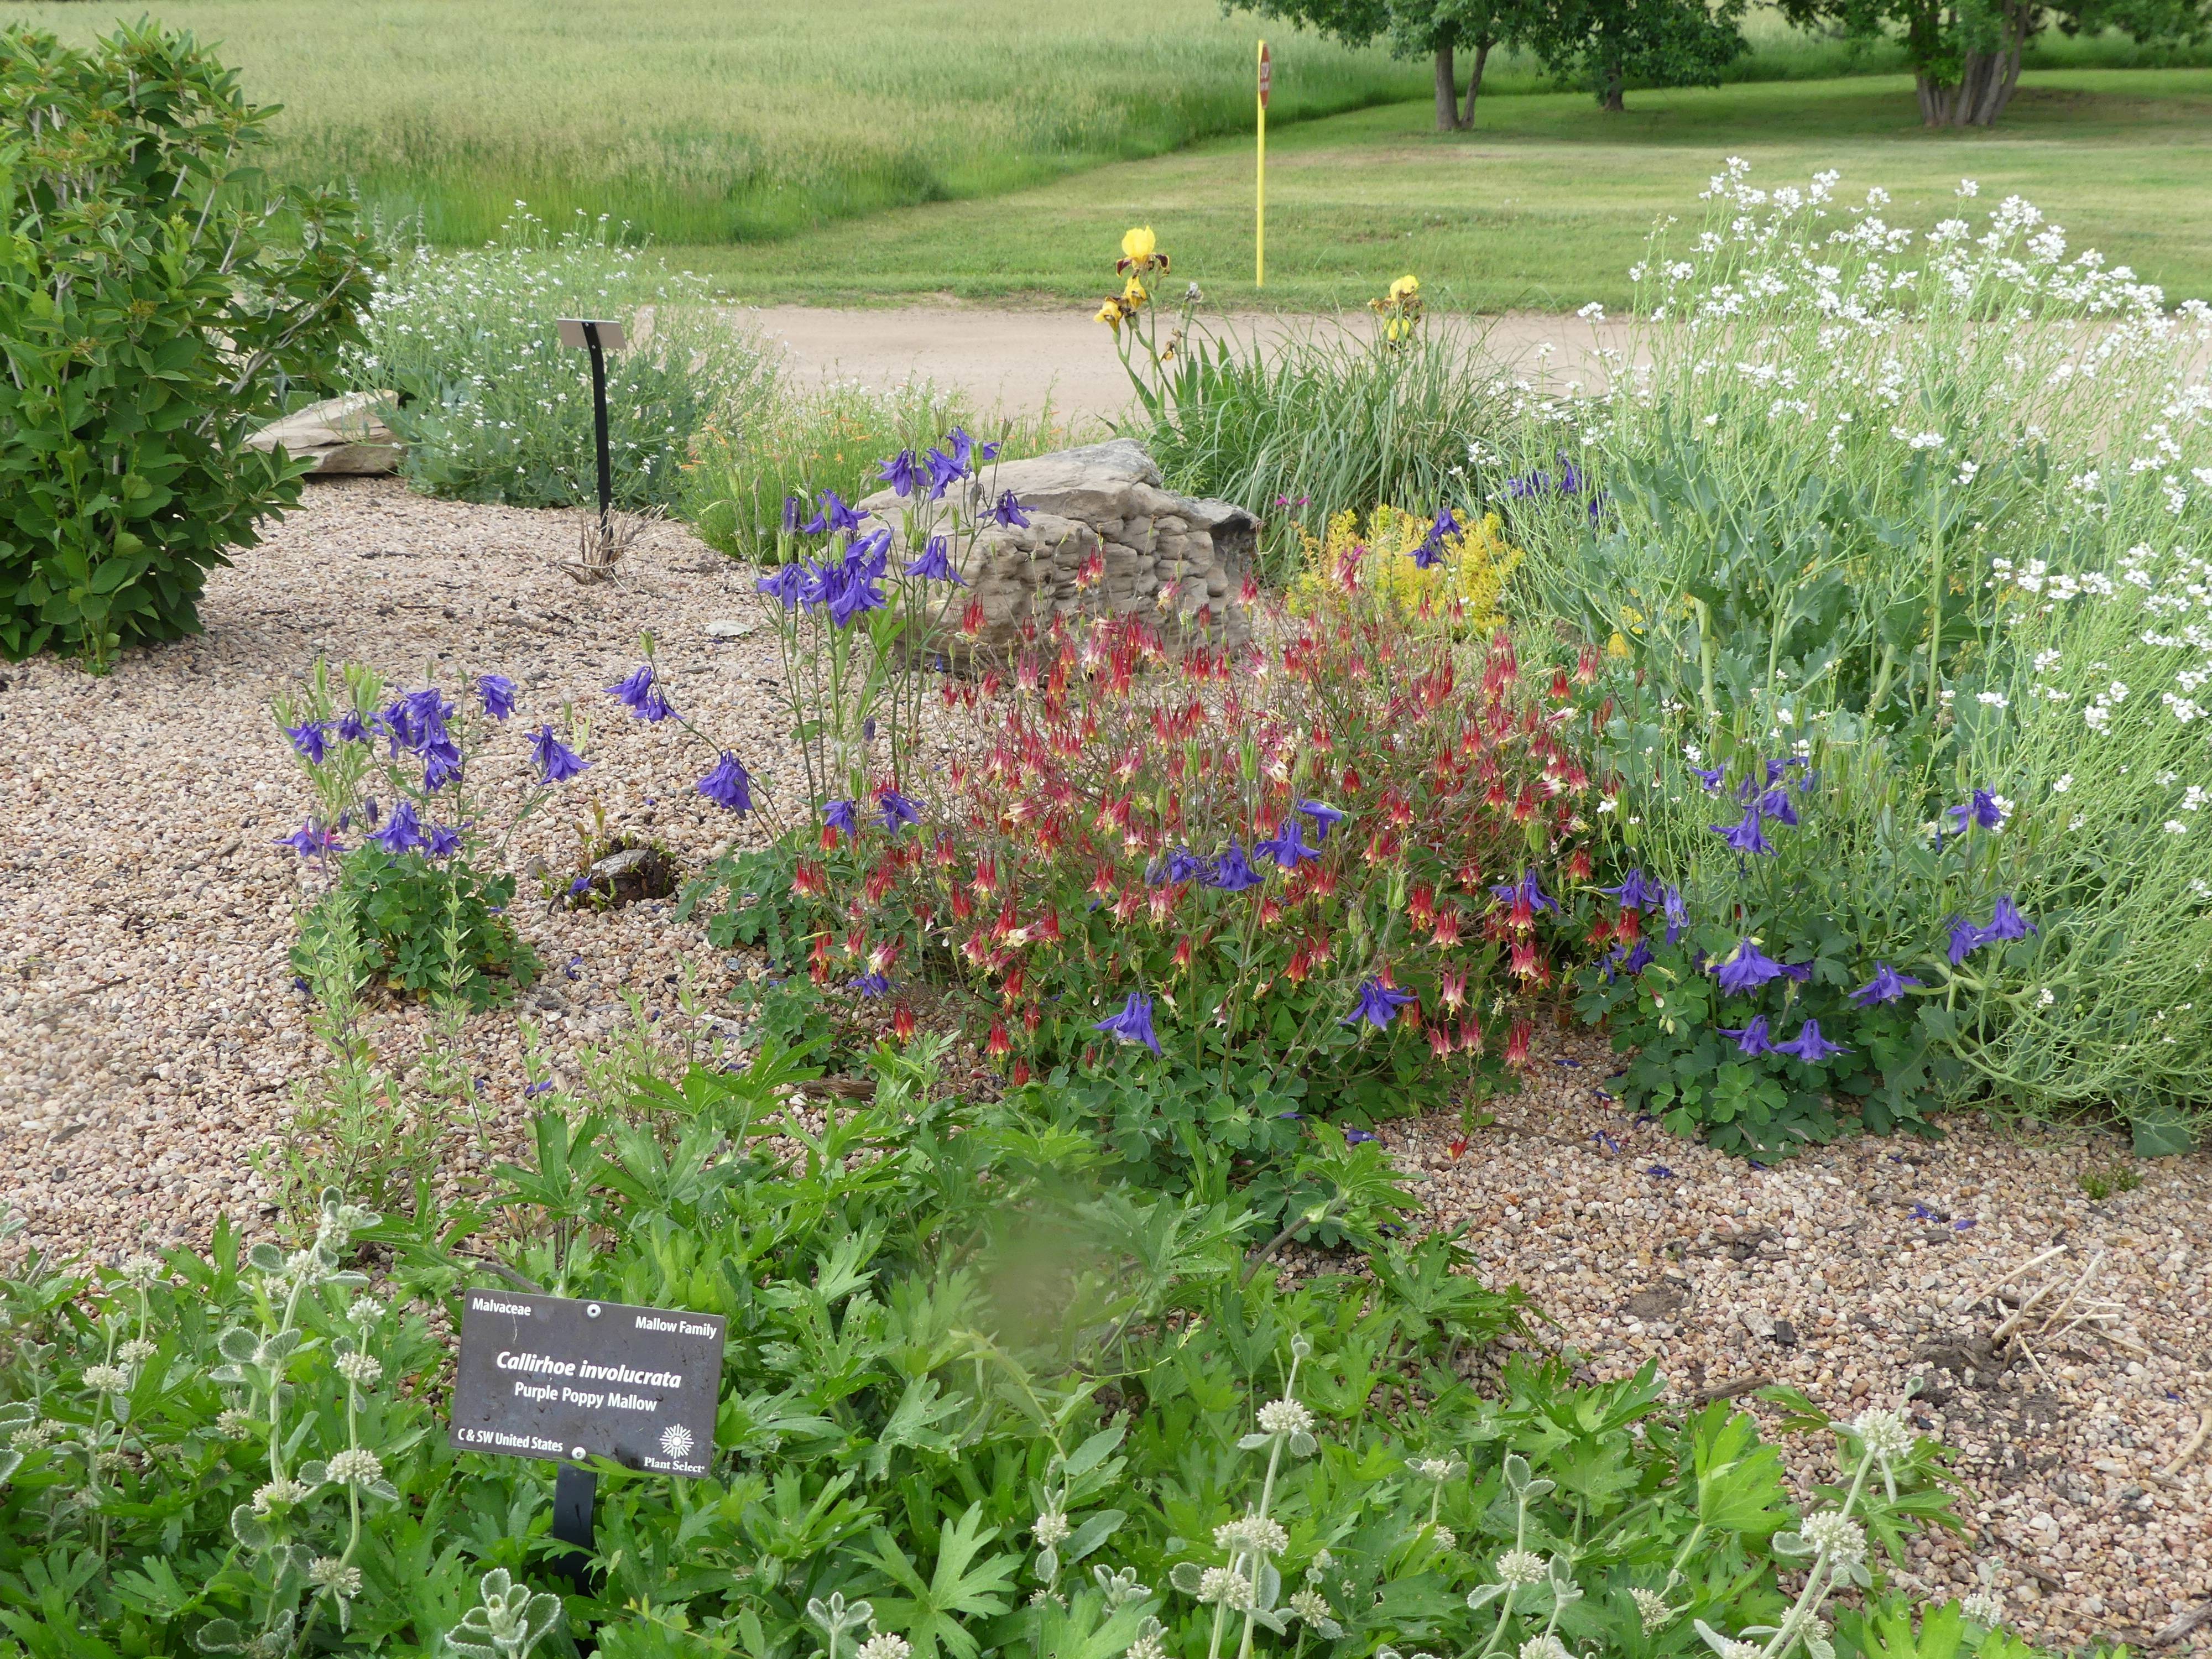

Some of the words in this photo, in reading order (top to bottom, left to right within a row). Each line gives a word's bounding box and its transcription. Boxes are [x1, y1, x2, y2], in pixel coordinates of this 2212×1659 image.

[472, 1297, 531, 1316] Malvaceae
[635, 1316, 677, 1333] Mallow
[680, 1320, 717, 1339] Family
[497, 1352, 576, 1376] Callirhoe
[579, 1360, 681, 1388] involucrata
[515, 1381, 558, 1401] Purple
[562, 1390, 604, 1408] Poppy
[608, 1392, 657, 1411] Mallow
[458, 1428, 465, 1440] C
[466, 1430, 475, 1441] &
[477, 1430, 494, 1443] SW
[495, 1432, 529, 1448] United
[531, 1436, 563, 1452] States
[644, 1457, 671, 1470] Plant
